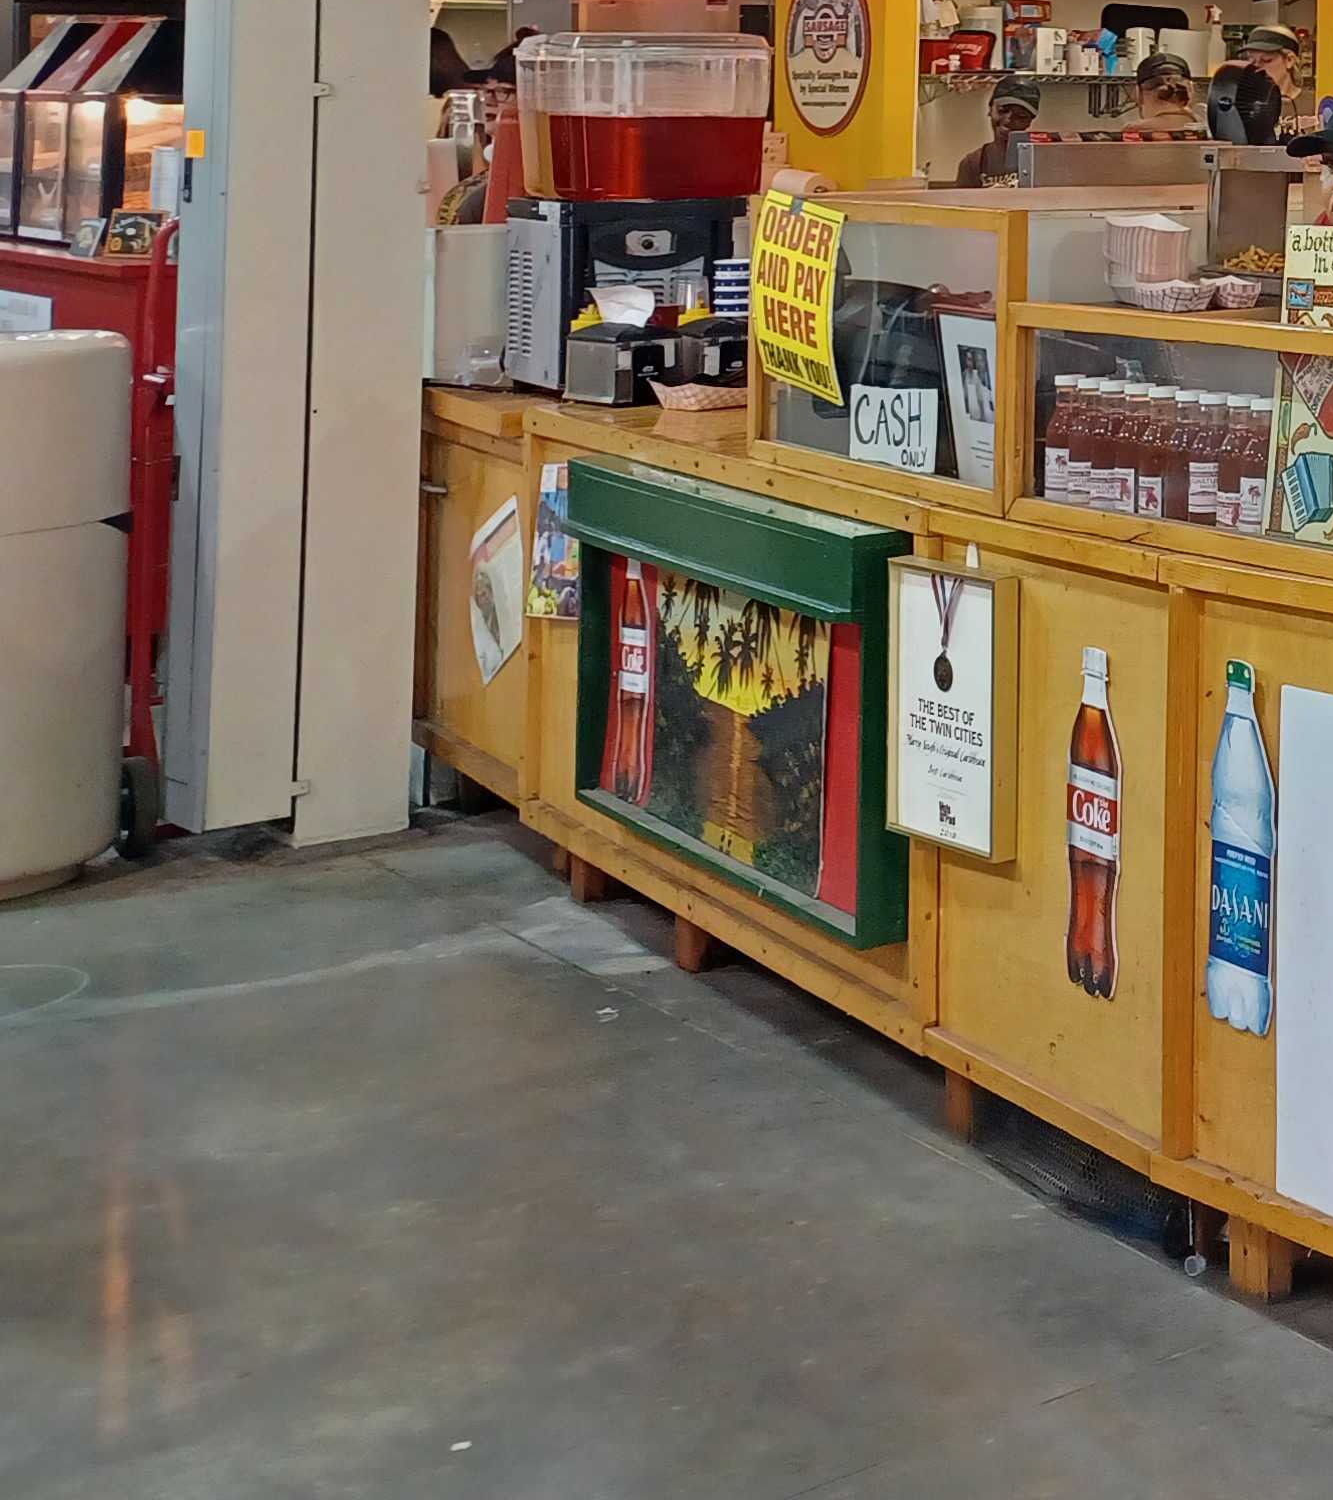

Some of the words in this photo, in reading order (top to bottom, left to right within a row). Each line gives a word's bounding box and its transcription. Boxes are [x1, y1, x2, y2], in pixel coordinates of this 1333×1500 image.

[805, 19, 848, 32] SAUSAGE
[761, 205, 833, 262] ORDER
[756, 249, 790, 293] AND
[793, 261, 827, 307] PAY
[1313, 253, 1329, 273] in
[762, 294, 818, 350] HERE
[760, 338, 802, 379] THANK
[800, 354, 831, 391] YOU!
[854, 391, 923, 448] CASH
[900, 448, 927, 469] ONLY
[909, 712, 927, 732] THE
[928, 717, 953, 740] TWIN
[953, 725, 984, 748] CITIES
[918, 698, 936, 717] THE
[936, 702, 961, 723] BEST
[962, 709, 975, 727] OF
[1072, 789, 1111, 833] Coke
[1211, 883, 1269, 930] DASANI
